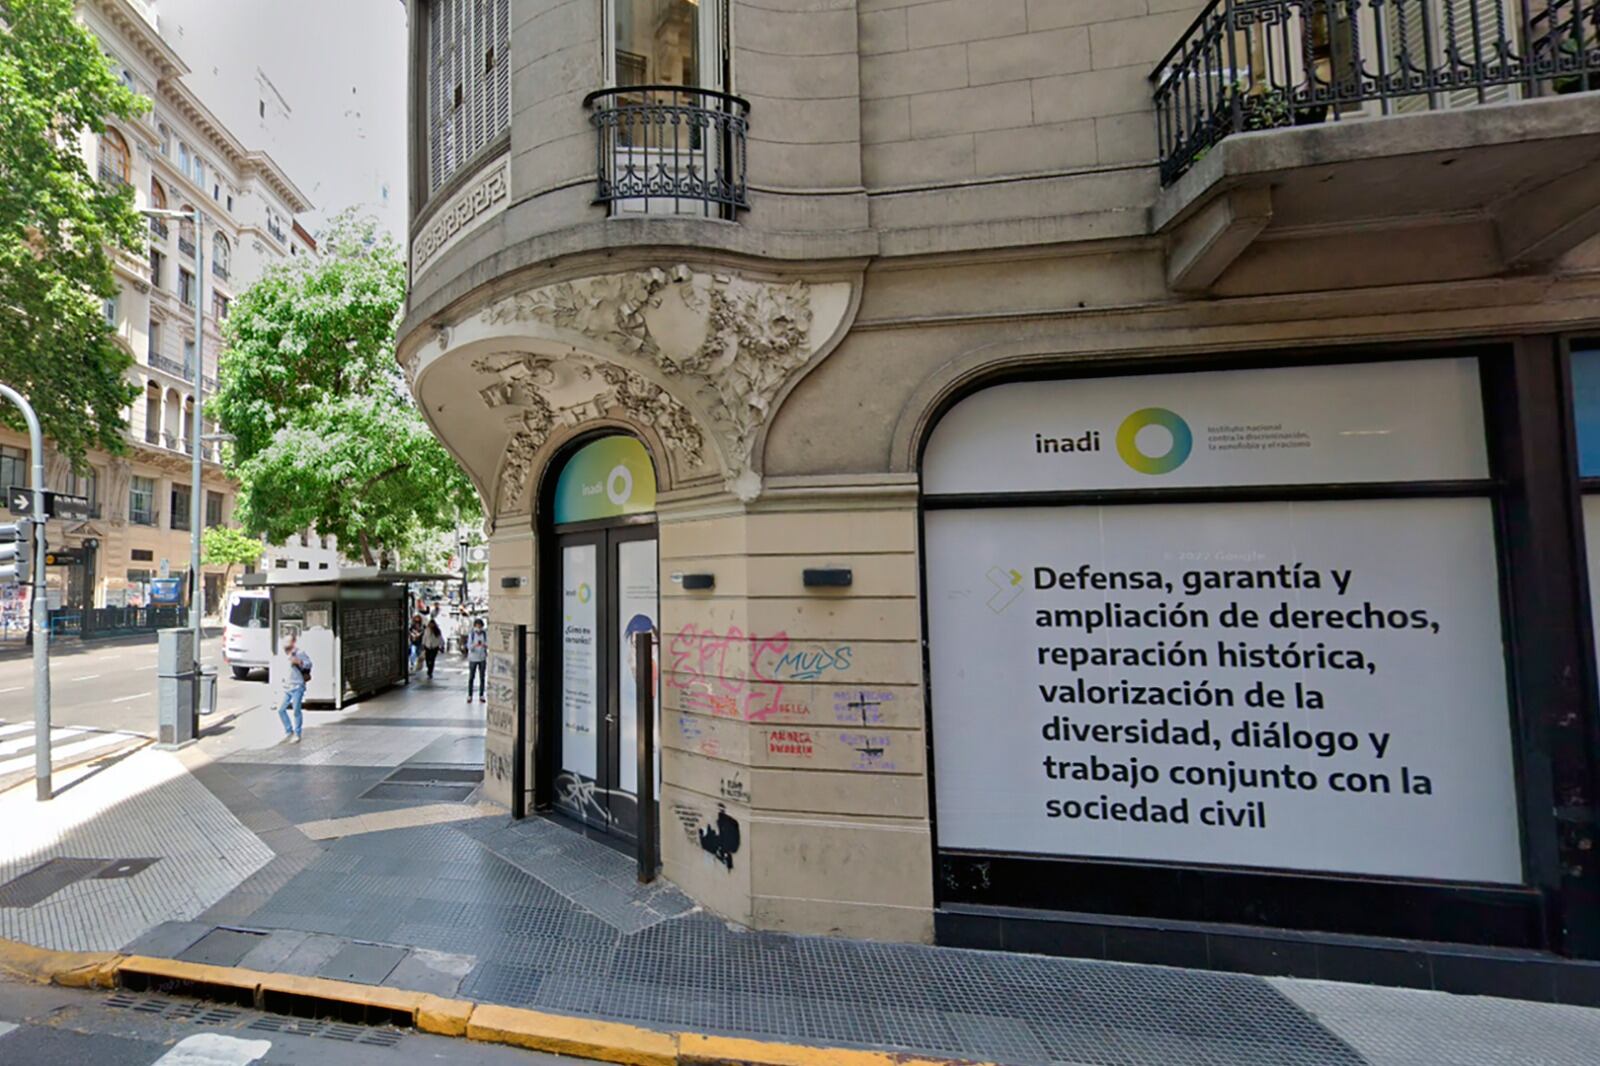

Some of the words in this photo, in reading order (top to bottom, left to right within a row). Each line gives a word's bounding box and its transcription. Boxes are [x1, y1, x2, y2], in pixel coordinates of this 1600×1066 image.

[1035, 431, 1101, 454] inadi
[1246, 424, 1282, 432] nacional
[581, 481, 603, 497] inadi
[1035, 564, 1173, 594] Defensa,
[1183, 562, 1321, 596] garantía
[1331, 570, 1352, 596] y
[1036, 602, 1209, 634] ampliación
[1220, 602, 1259, 629] de
[1269, 602, 1440, 634] derechos,
[1039, 641, 1208, 672] reparación
[1218, 641, 1376, 675] histórica,
[1039, 678, 1233, 707] valorización
[1245, 682, 1285, 709] de
[1296, 683, 1324, 710] la
[1043, 716, 1221, 751] diversidad,
[1232, 721, 1359, 758] diálogo
[1369, 733, 1390, 759] y
[1043, 756, 1159, 789] trabajo
[1169, 761, 1318, 793] conjunto
[1328, 773, 1391, 794] con
[1402, 767, 1432, 795] la
[1047, 795, 1189, 825] sociedad
[1199, 801, 1266, 829] civil
